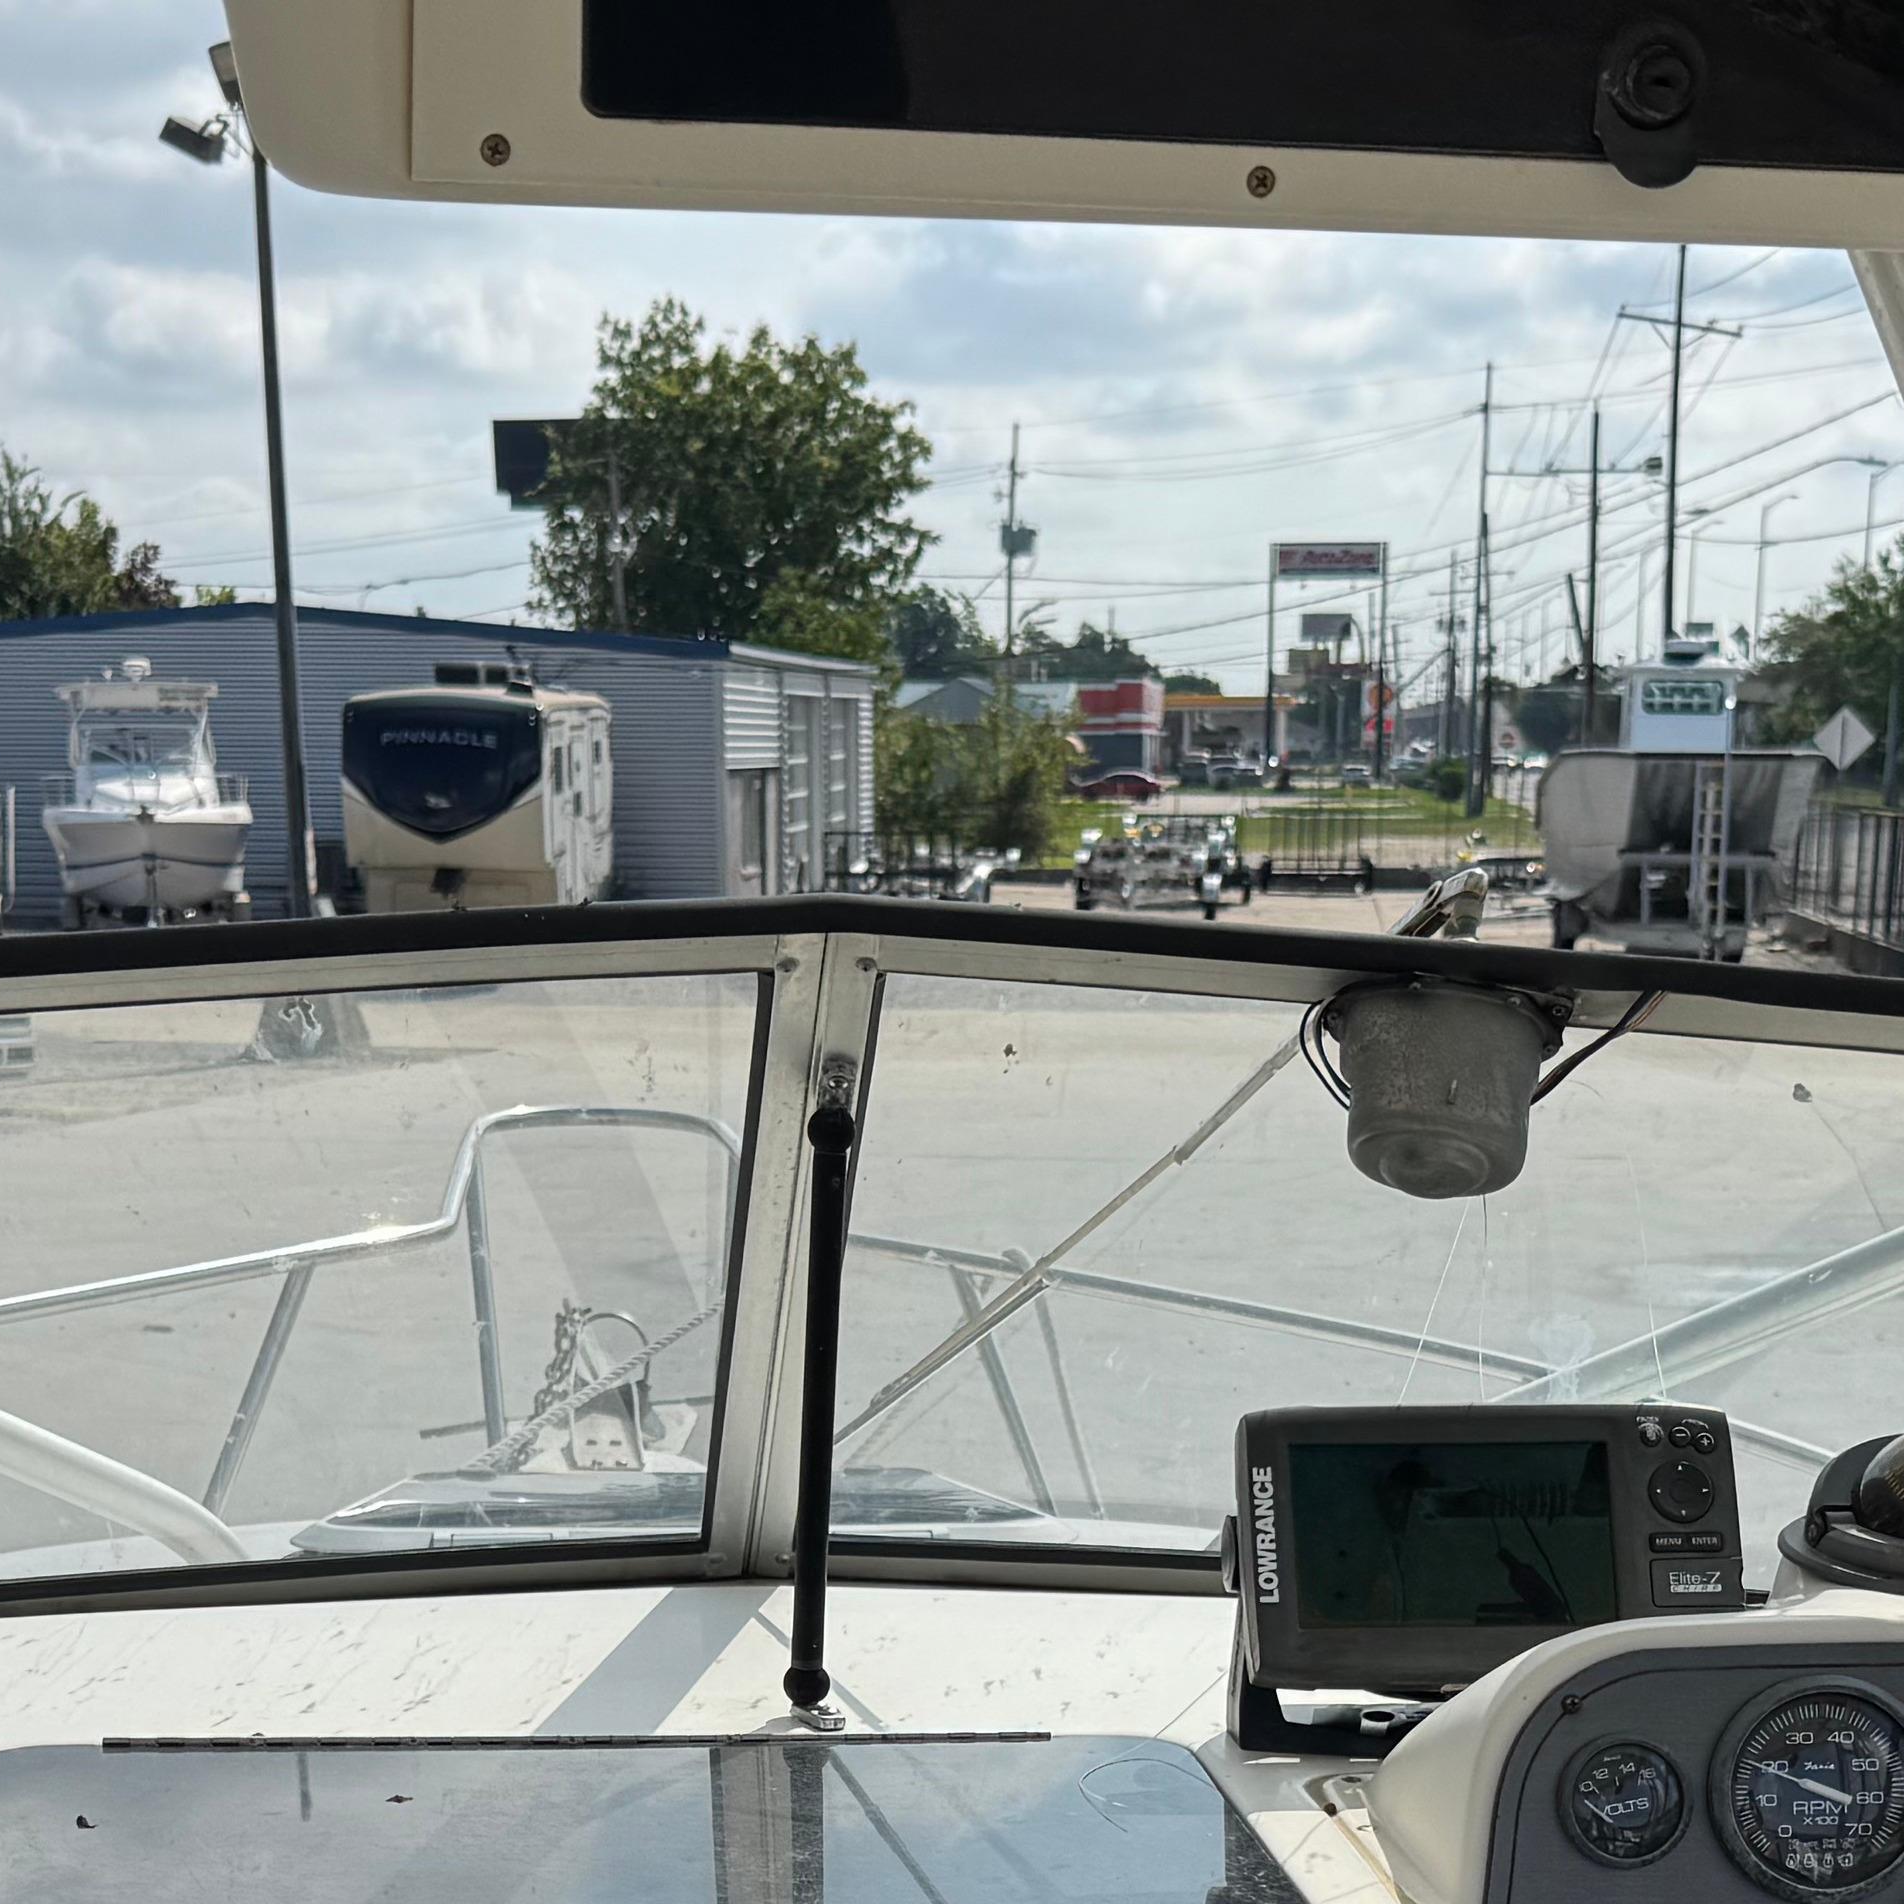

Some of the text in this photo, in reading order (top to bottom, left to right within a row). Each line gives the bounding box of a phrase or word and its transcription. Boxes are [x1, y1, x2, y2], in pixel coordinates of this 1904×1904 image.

[380, 729, 496, 749] PINNACLE
[1251, 1466, 1280, 1604] LOWRANCE
[1691, 1537, 1717, 1545] ENTER
[1669, 1571, 1721, 1585] Elite-7
[1785, 1730, 1855, 1745] 30 40
[1592, 1763, 1636, 1779] 12 14
[1761, 1760, 1789, 1774] 20
[1851, 1758, 1880, 1771] 50
[1601, 1797, 1649, 1816] VOLTS
[1755, 1791, 1885, 1807] 10 60
[1793, 1800, 1848, 1816] RPM
[1778, 1823, 1873, 1838] 0 70
